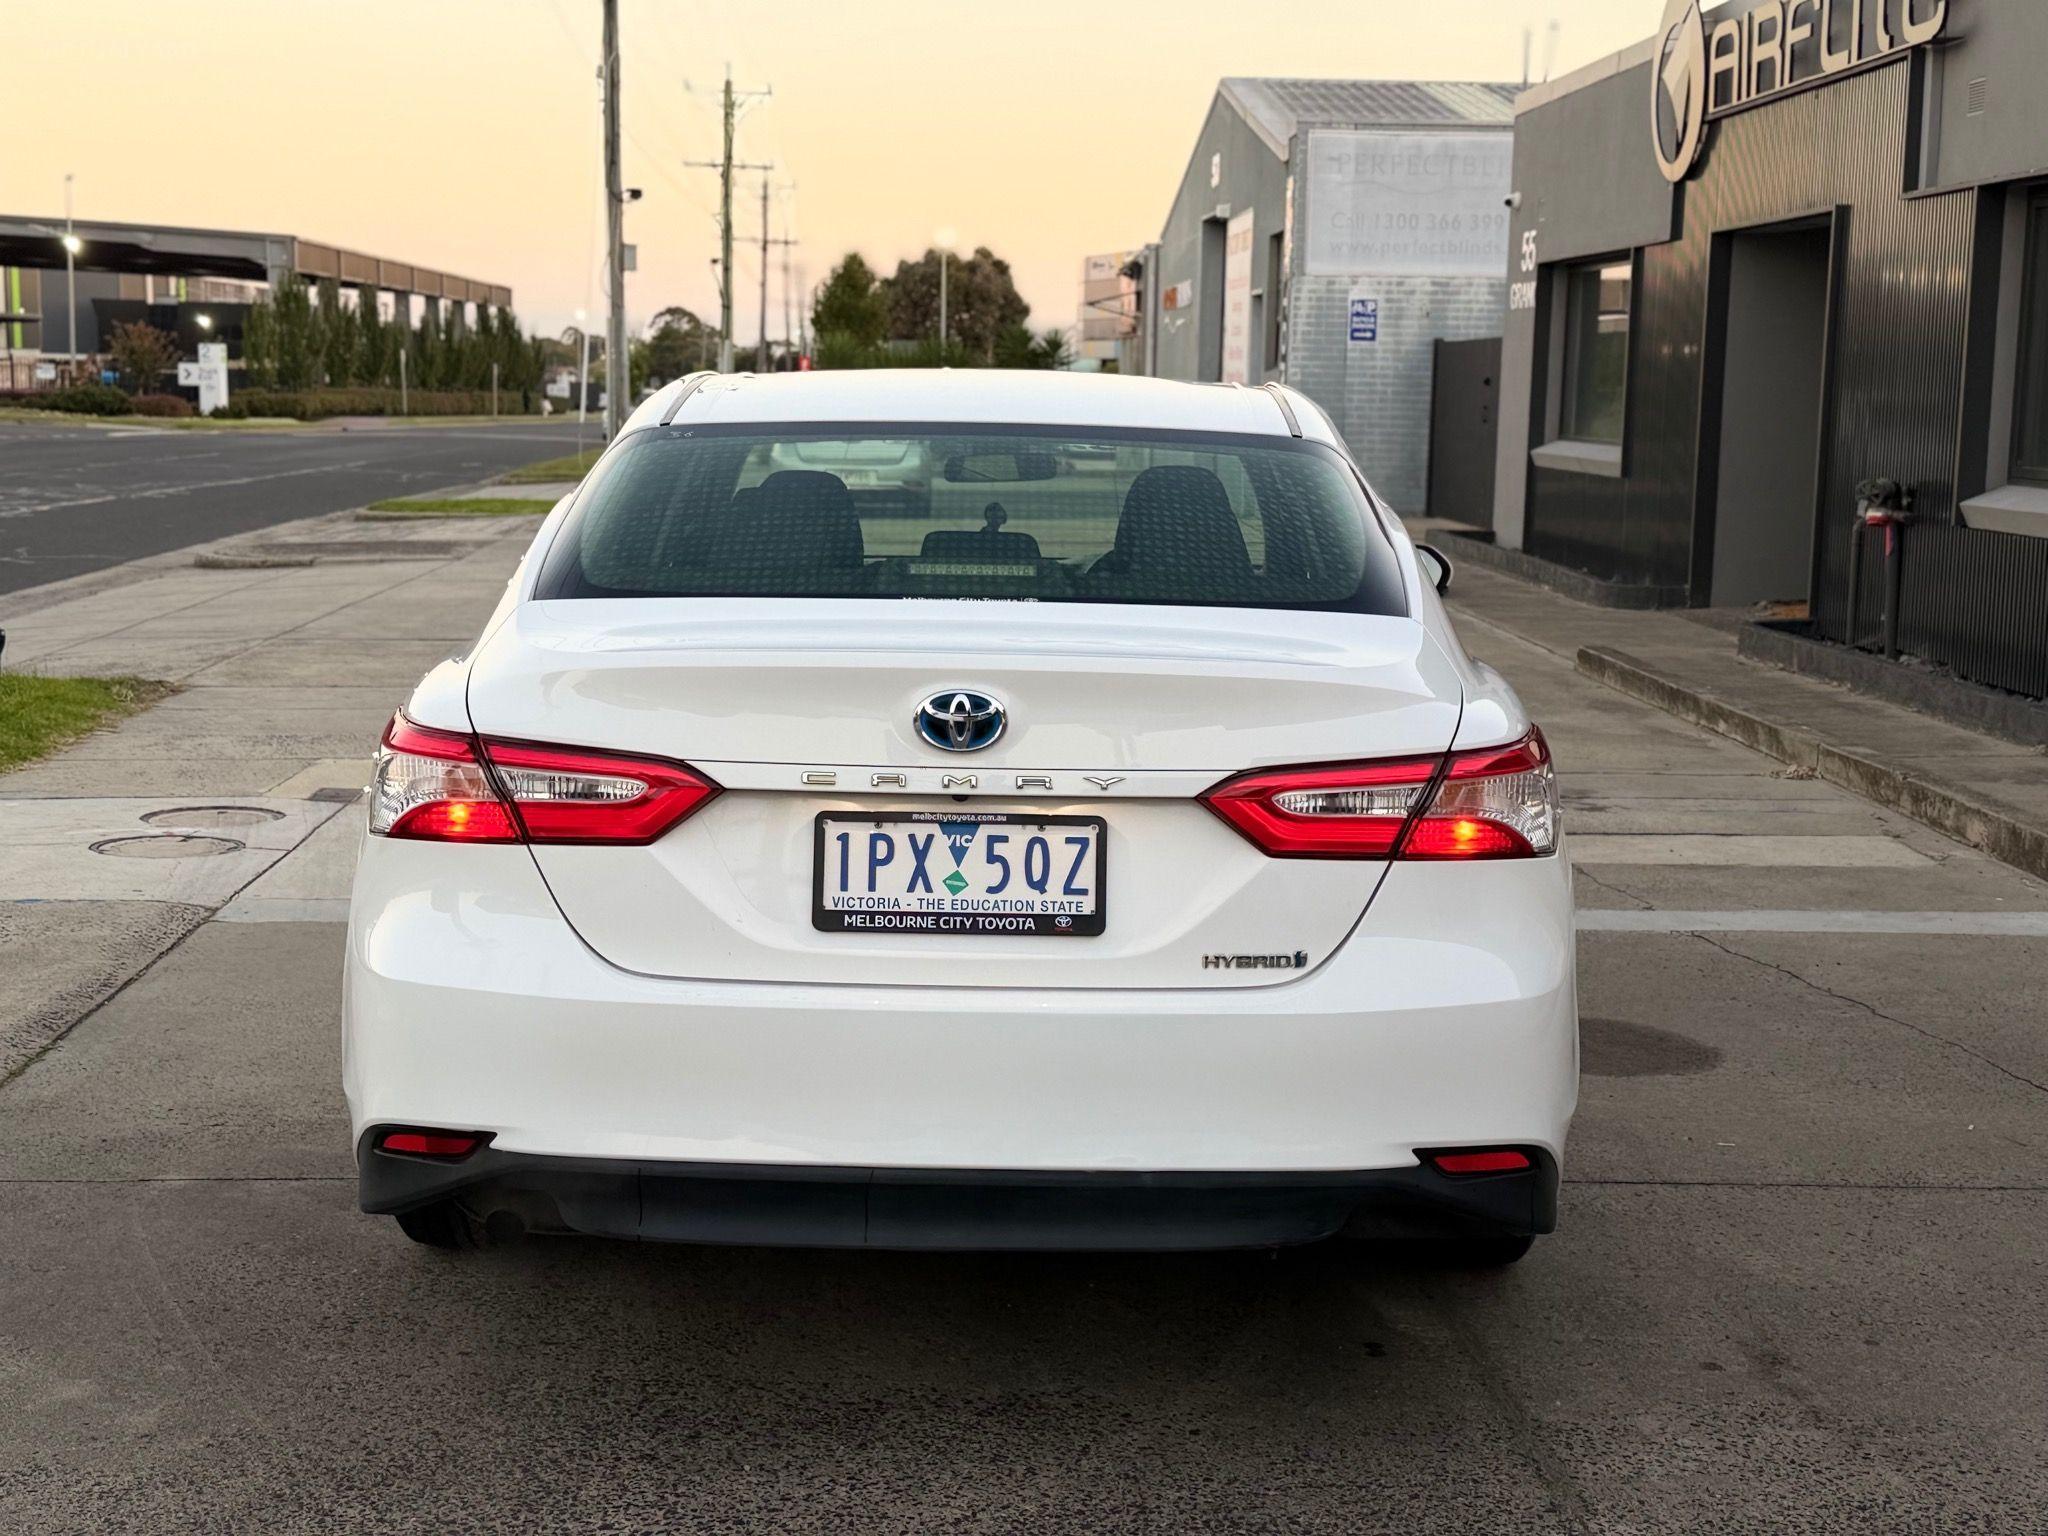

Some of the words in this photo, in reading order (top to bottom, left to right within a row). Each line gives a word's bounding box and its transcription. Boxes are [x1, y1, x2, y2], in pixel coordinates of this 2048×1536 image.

[1330, 211, 1365, 231] Call
[1374, 212, 1420, 231] 1300
[1425, 213, 1462, 231] 366
[800, 770, 1127, 791] CAMRY
[912, 812, 1007, 823] melbcitytoyota.com.au
[943, 833, 974, 848] VIC
[835, 832, 935, 893] 1PX
[985, 834, 1090, 896] 5QZ
[832, 896, 901, 909] VICTORIA
[917, 898, 946, 911] THE
[951, 899, 1035, 912] EDUCATION
[1040, 900, 1084, 913] STATE
[843, 914, 937, 929] MELBOURNE
[940, 916, 974, 930] CITY
[976, 916, 1036, 930] TOYOTA
[1202, 955, 1292, 969] HYBRID
